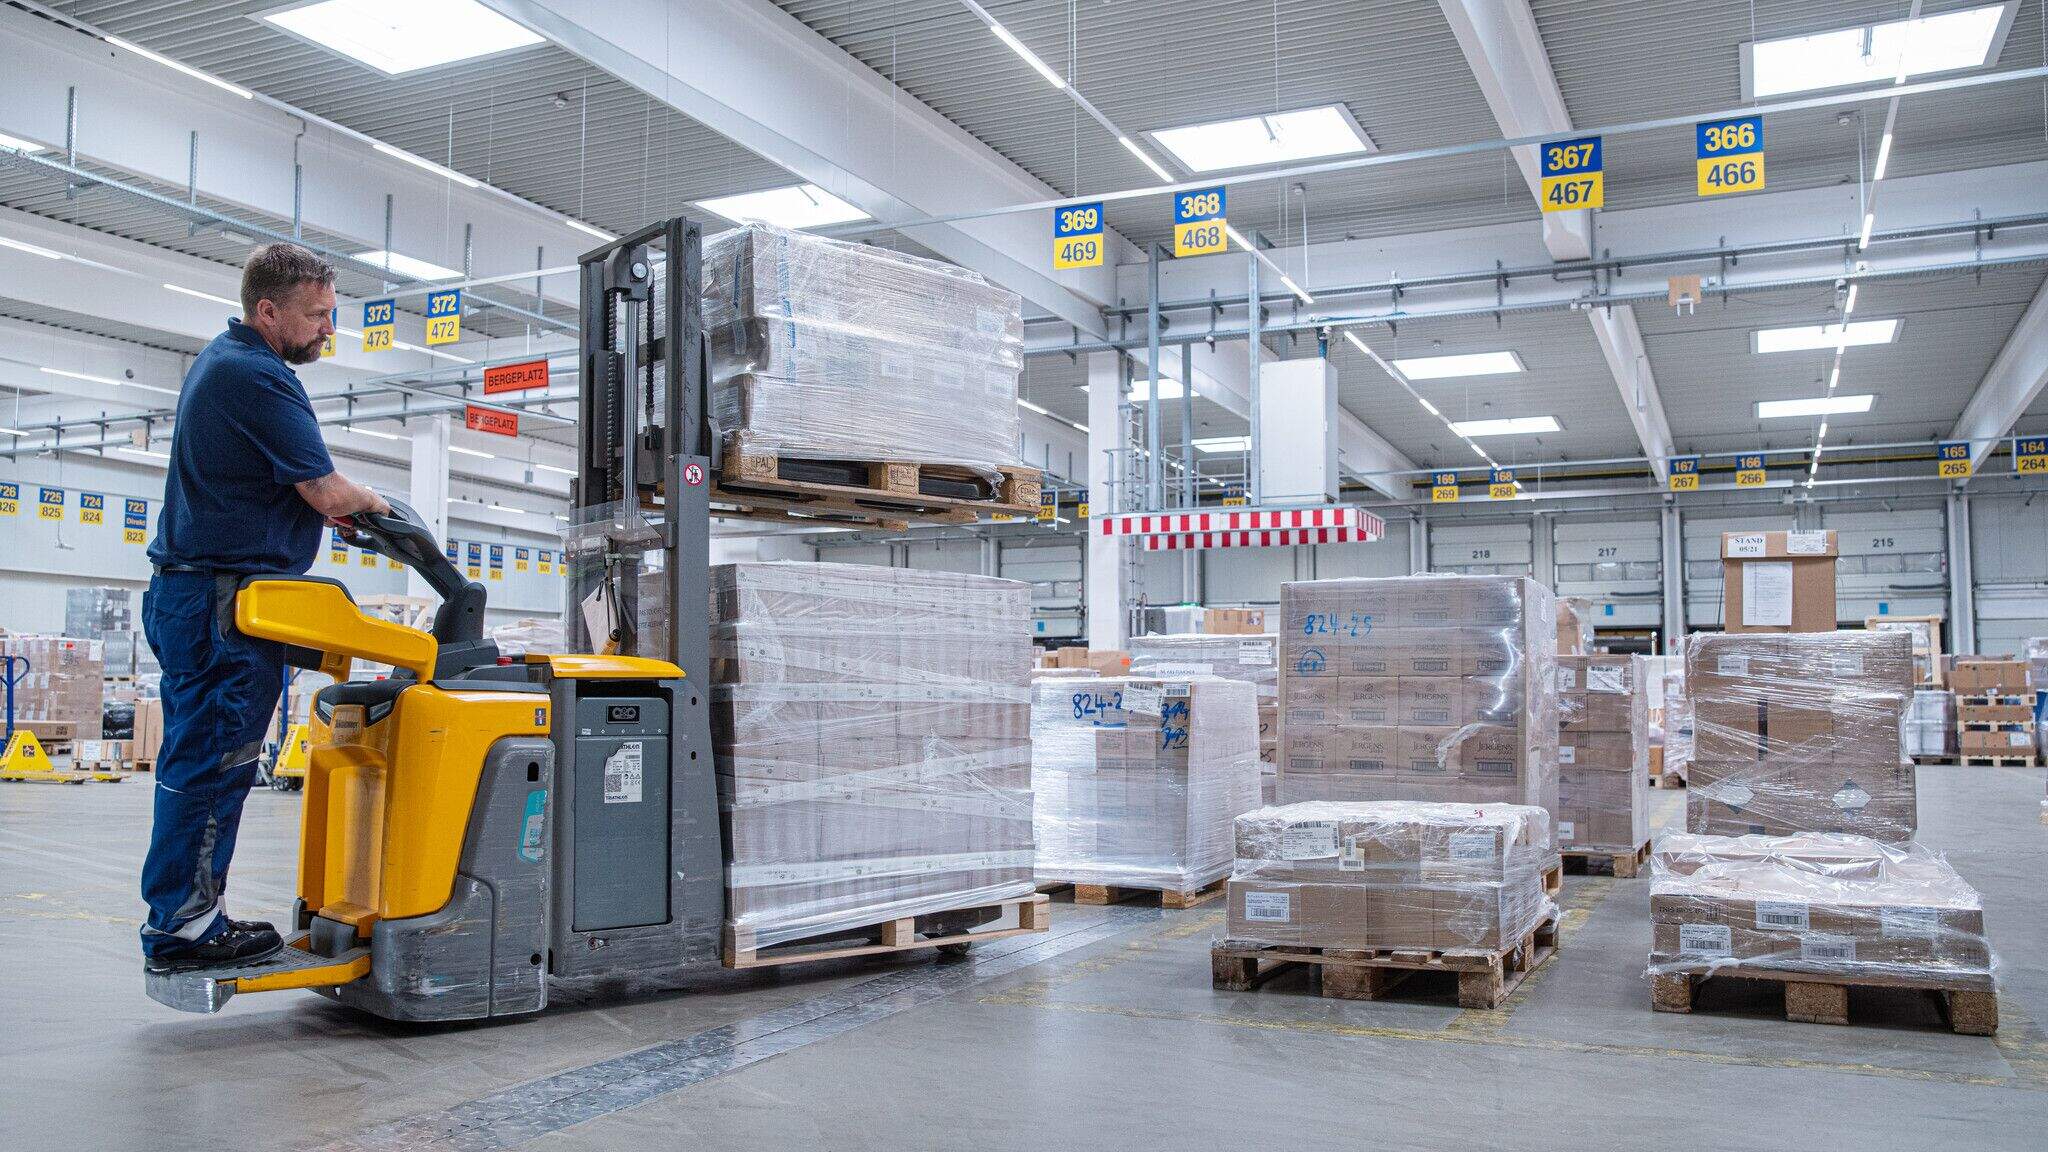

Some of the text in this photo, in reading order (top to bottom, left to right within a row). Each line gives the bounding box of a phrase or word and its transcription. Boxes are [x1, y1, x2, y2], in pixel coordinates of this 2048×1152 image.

[1705, 123, 1755, 152] 366
[1548, 143, 1594, 171] 367
[1707, 161, 1756, 187] 466
[1549, 180, 1594, 205] 467
[1181, 192, 1220, 218] 368
[1060, 208, 1097, 232] 369
[1182, 226, 1220, 249] 468
[1061, 241, 1096, 262] 469
[431, 294, 457, 314] 372
[367, 304, 391, 323] 373
[431, 321, 455, 339] 472
[366, 329, 389, 347] 473
[488, 368, 544, 387] BERGEPLATZ
[1942, 446, 1967, 458] 165
[2020, 441, 2045, 453] 164
[1673, 460, 1695, 472] 167
[1740, 456, 1761, 469] 166
[1943, 462, 1967, 474] 265
[2021, 458, 2046, 470] 264
[1436, 473, 1455, 485] 169
[1493, 471, 1513, 482] 168
[1674, 477, 1694, 488] 267
[1740, 474, 1762, 484] 266
[44, 489, 63, 503] 725
[1436, 489, 1455, 499] 269
[1493, 487, 1512, 497] 268
[83, 495, 102, 507] 724
[127, 501, 146, 513] 723
[42, 507, 61, 518] 825
[82, 511, 101, 522] 824
[126, 531, 144, 542] 823
[1872, 538, 1894, 548] 215
[1472, 550, 1491, 559] 218
[1598, 547, 1617, 557] 217
